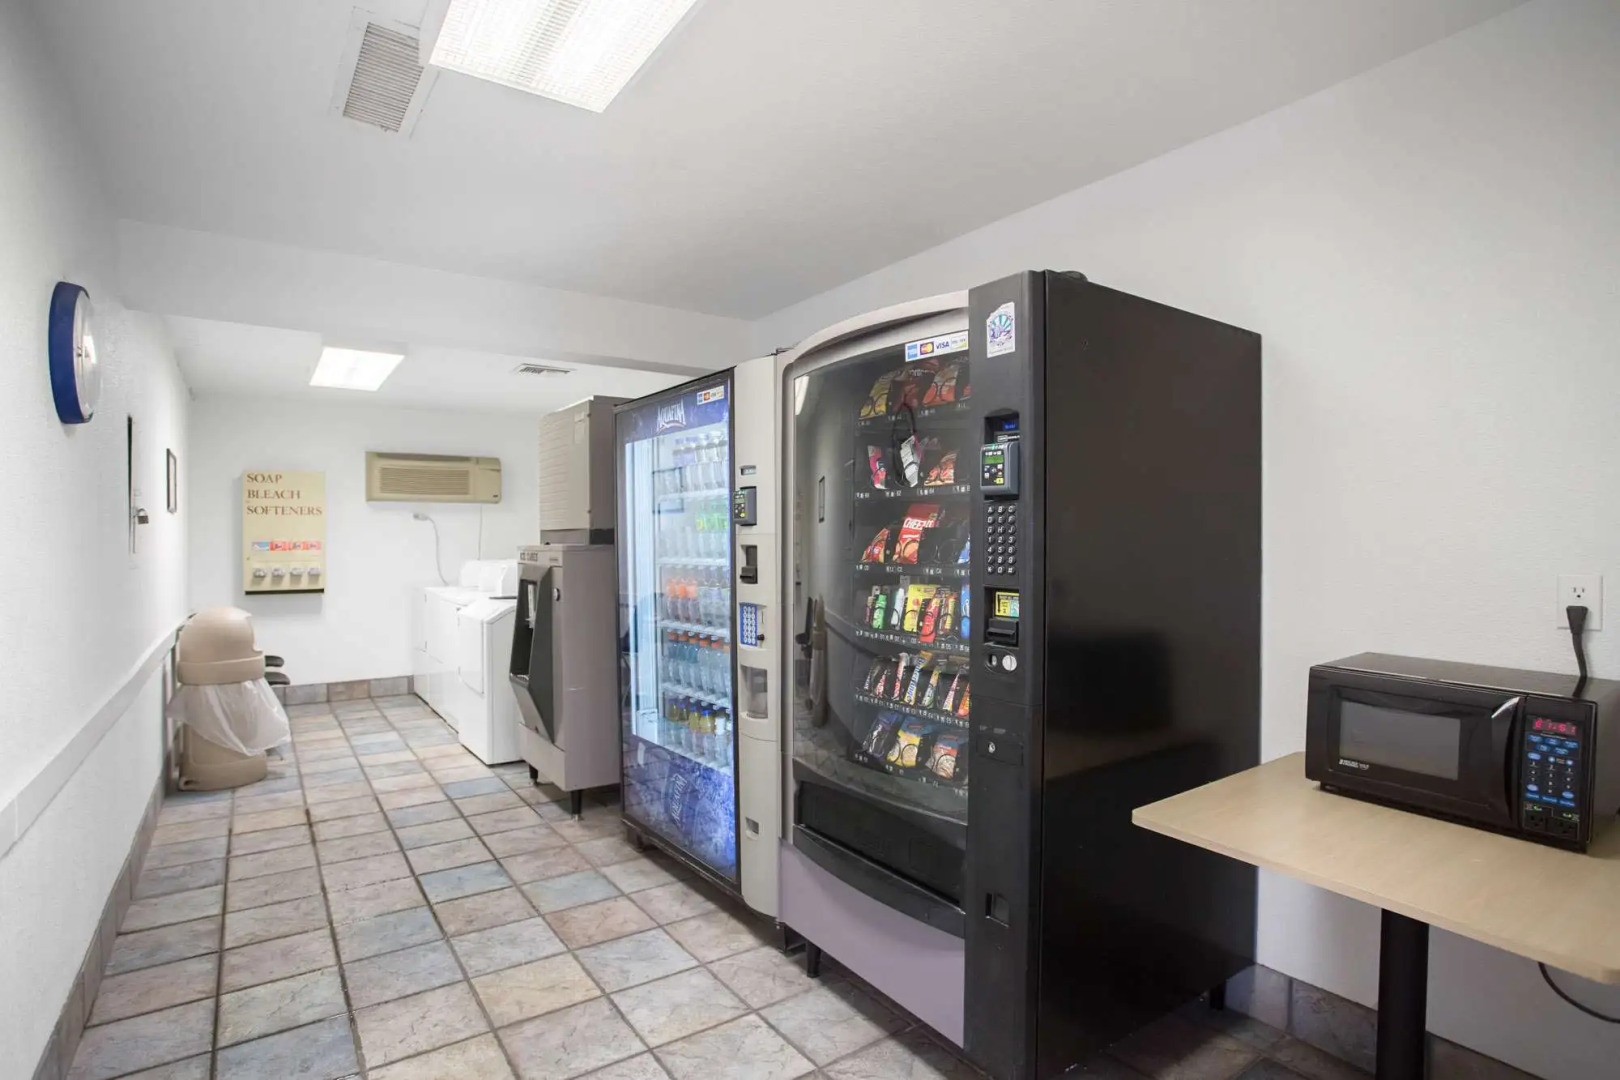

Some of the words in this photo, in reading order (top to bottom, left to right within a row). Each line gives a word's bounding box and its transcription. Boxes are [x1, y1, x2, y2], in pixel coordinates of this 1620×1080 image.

[936, 341, 950, 350] VISA
[246, 473, 282, 483] SOAP
[247, 489, 301, 500] BLEACH
[246, 505, 323, 516] SOFTENERS
